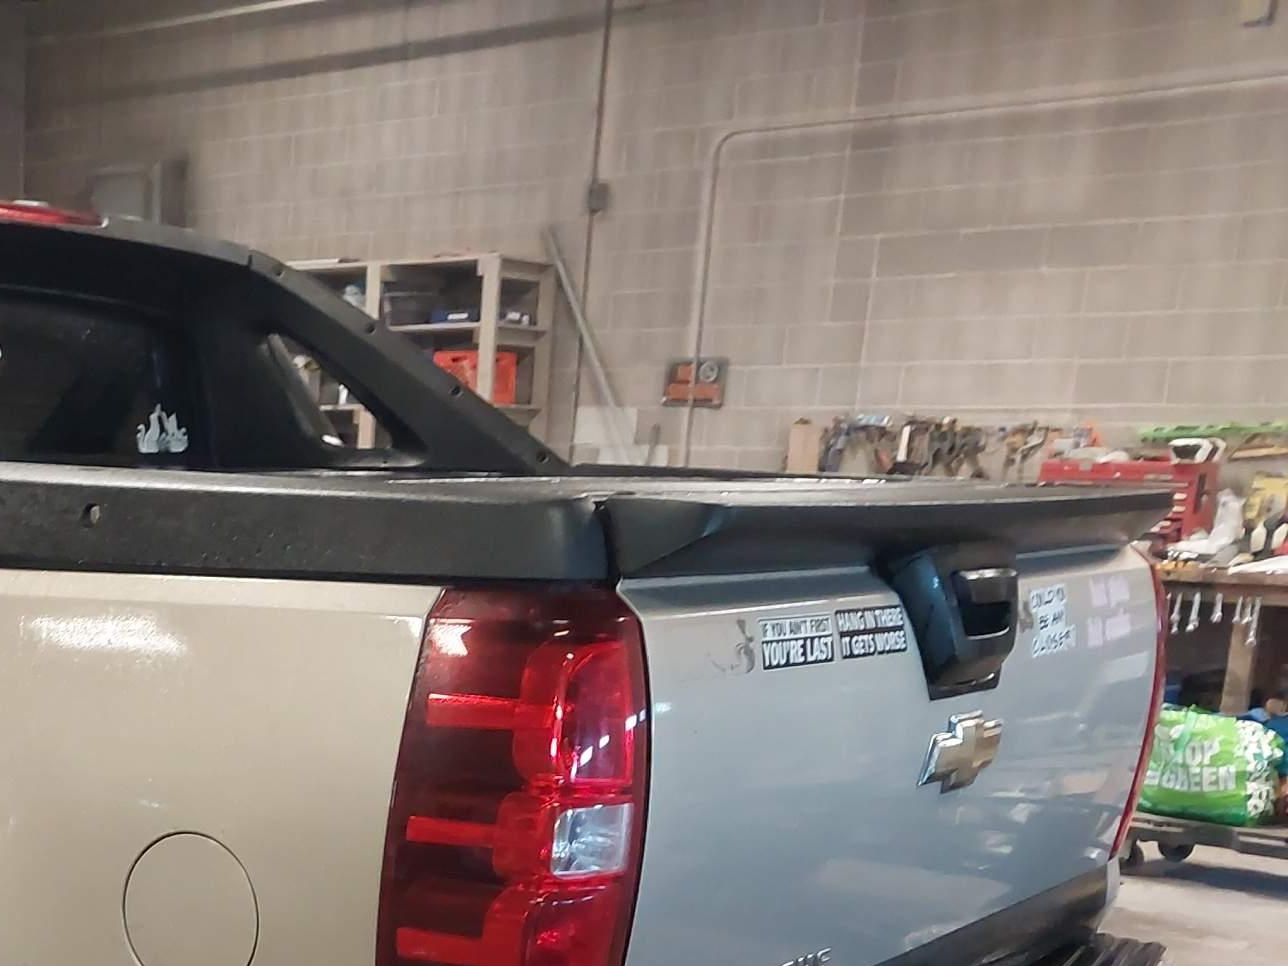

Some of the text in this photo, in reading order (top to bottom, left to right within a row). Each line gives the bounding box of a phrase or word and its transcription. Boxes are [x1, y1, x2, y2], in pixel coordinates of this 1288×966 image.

[772, 620, 787, 638] YOU
[837, 606, 904, 632] HANG IN THERE
[763, 636, 833, 667] YOU'RE LAST
[841, 630, 907, 657] IT GETS WORSE
